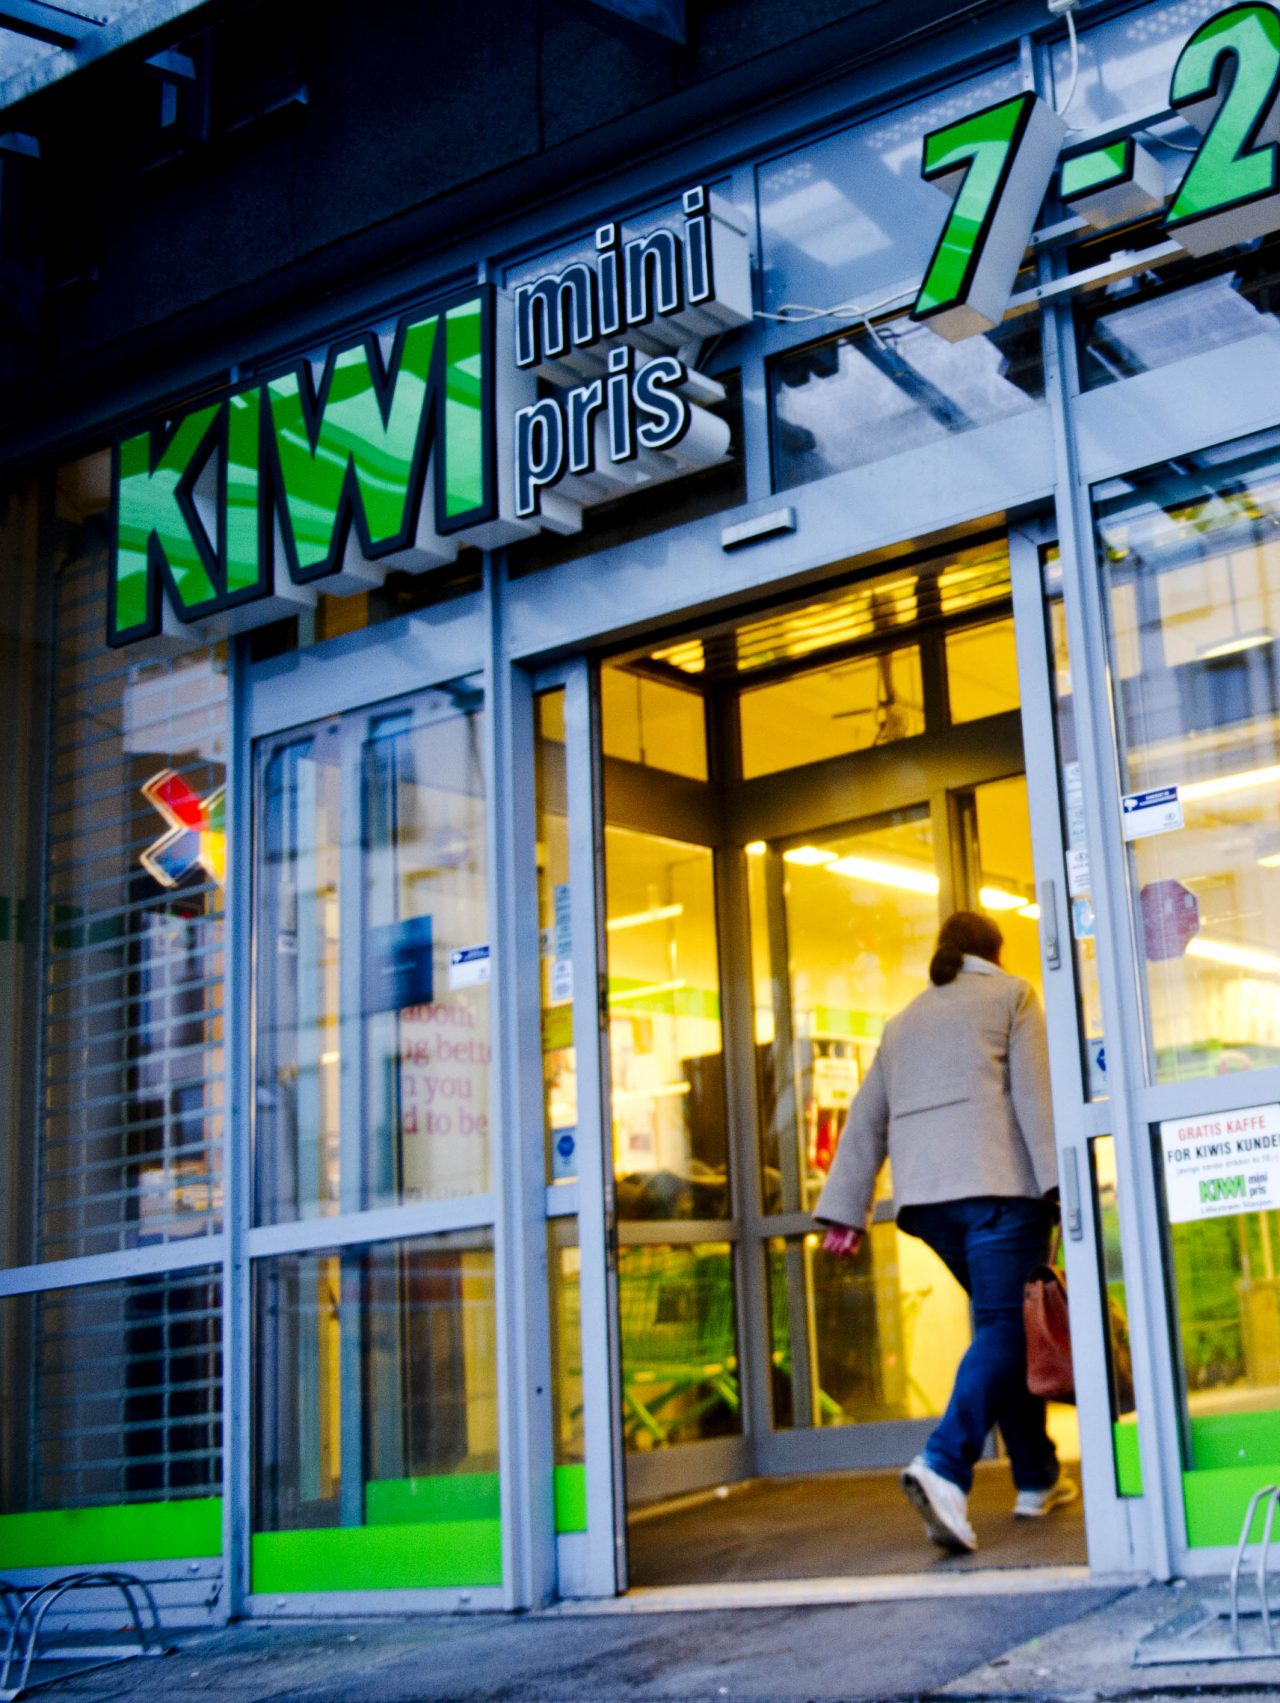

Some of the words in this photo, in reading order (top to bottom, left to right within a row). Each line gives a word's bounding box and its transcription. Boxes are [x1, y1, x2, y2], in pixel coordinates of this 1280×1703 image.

[514, 185, 711, 367] mini
[515, 346, 690, 517] pris
[107, 282, 498, 648] KIWI
[1178, 1122, 1222, 1141] GRATIS
[1226, 1115, 1265, 1134] KAFFE
[1167, 1148, 1191, 1163] FOR
[1195, 1142, 1232, 1159] KIWIS
[1199, 1174, 1247, 1203] KIWI
[1248, 1172, 1268, 1184] mini
[1249, 1184, 1267, 1198] pris
